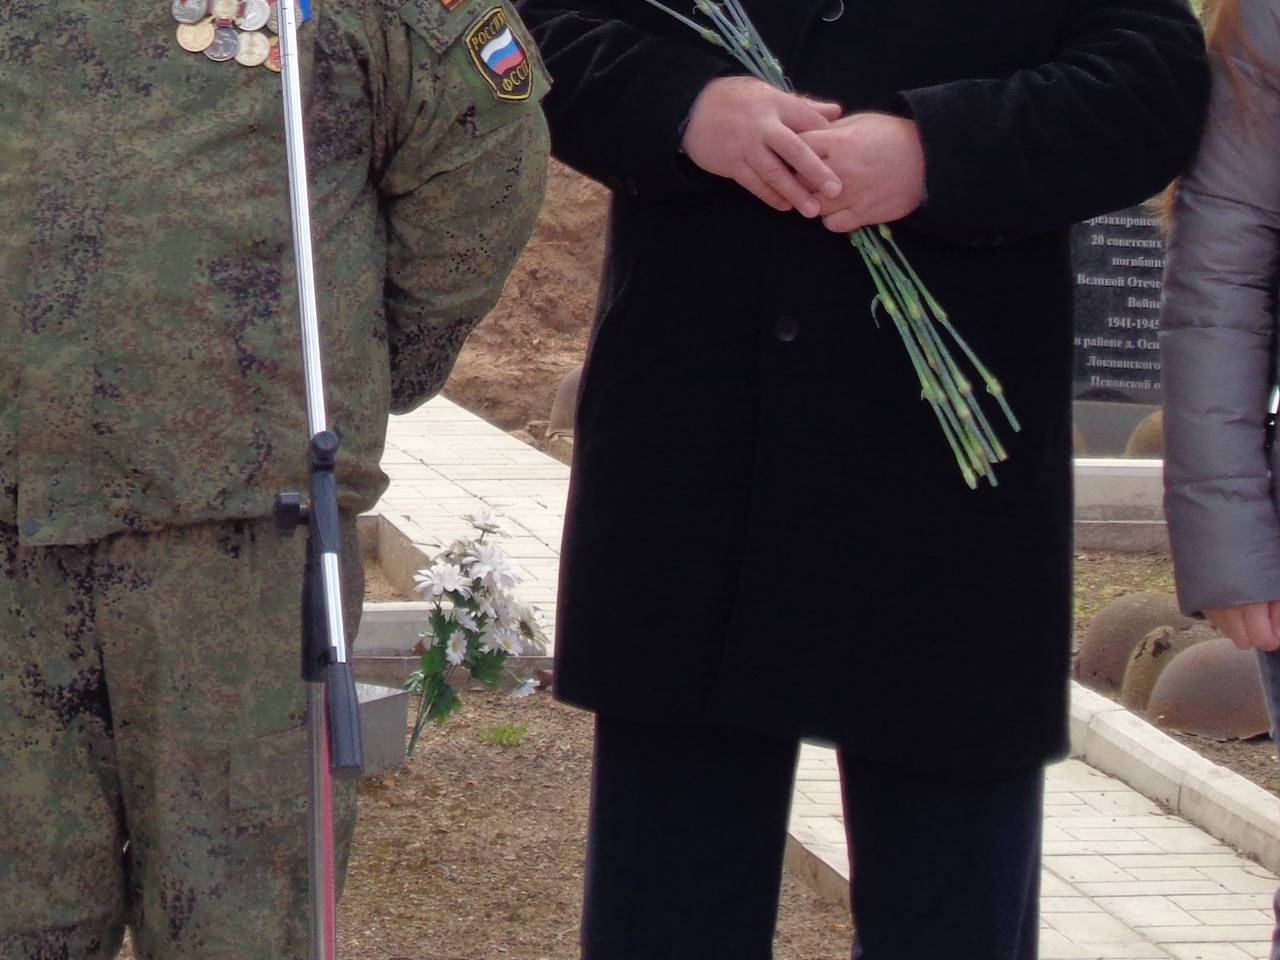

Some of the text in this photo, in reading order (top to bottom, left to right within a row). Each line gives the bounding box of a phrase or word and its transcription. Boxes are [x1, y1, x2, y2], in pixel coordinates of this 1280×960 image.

[471, 12, 506, 50] РОССИЯ
[502, 60, 529, 92] ФССП
[1091, 234, 1163, 249] 20 советских
[1076, 274, 1163, 289] Великой Отече
[1107, 316, 1160, 330] 1941-1945
[1083, 336, 1123, 350] районе
[1090, 375, 1151, 390] Псковской
